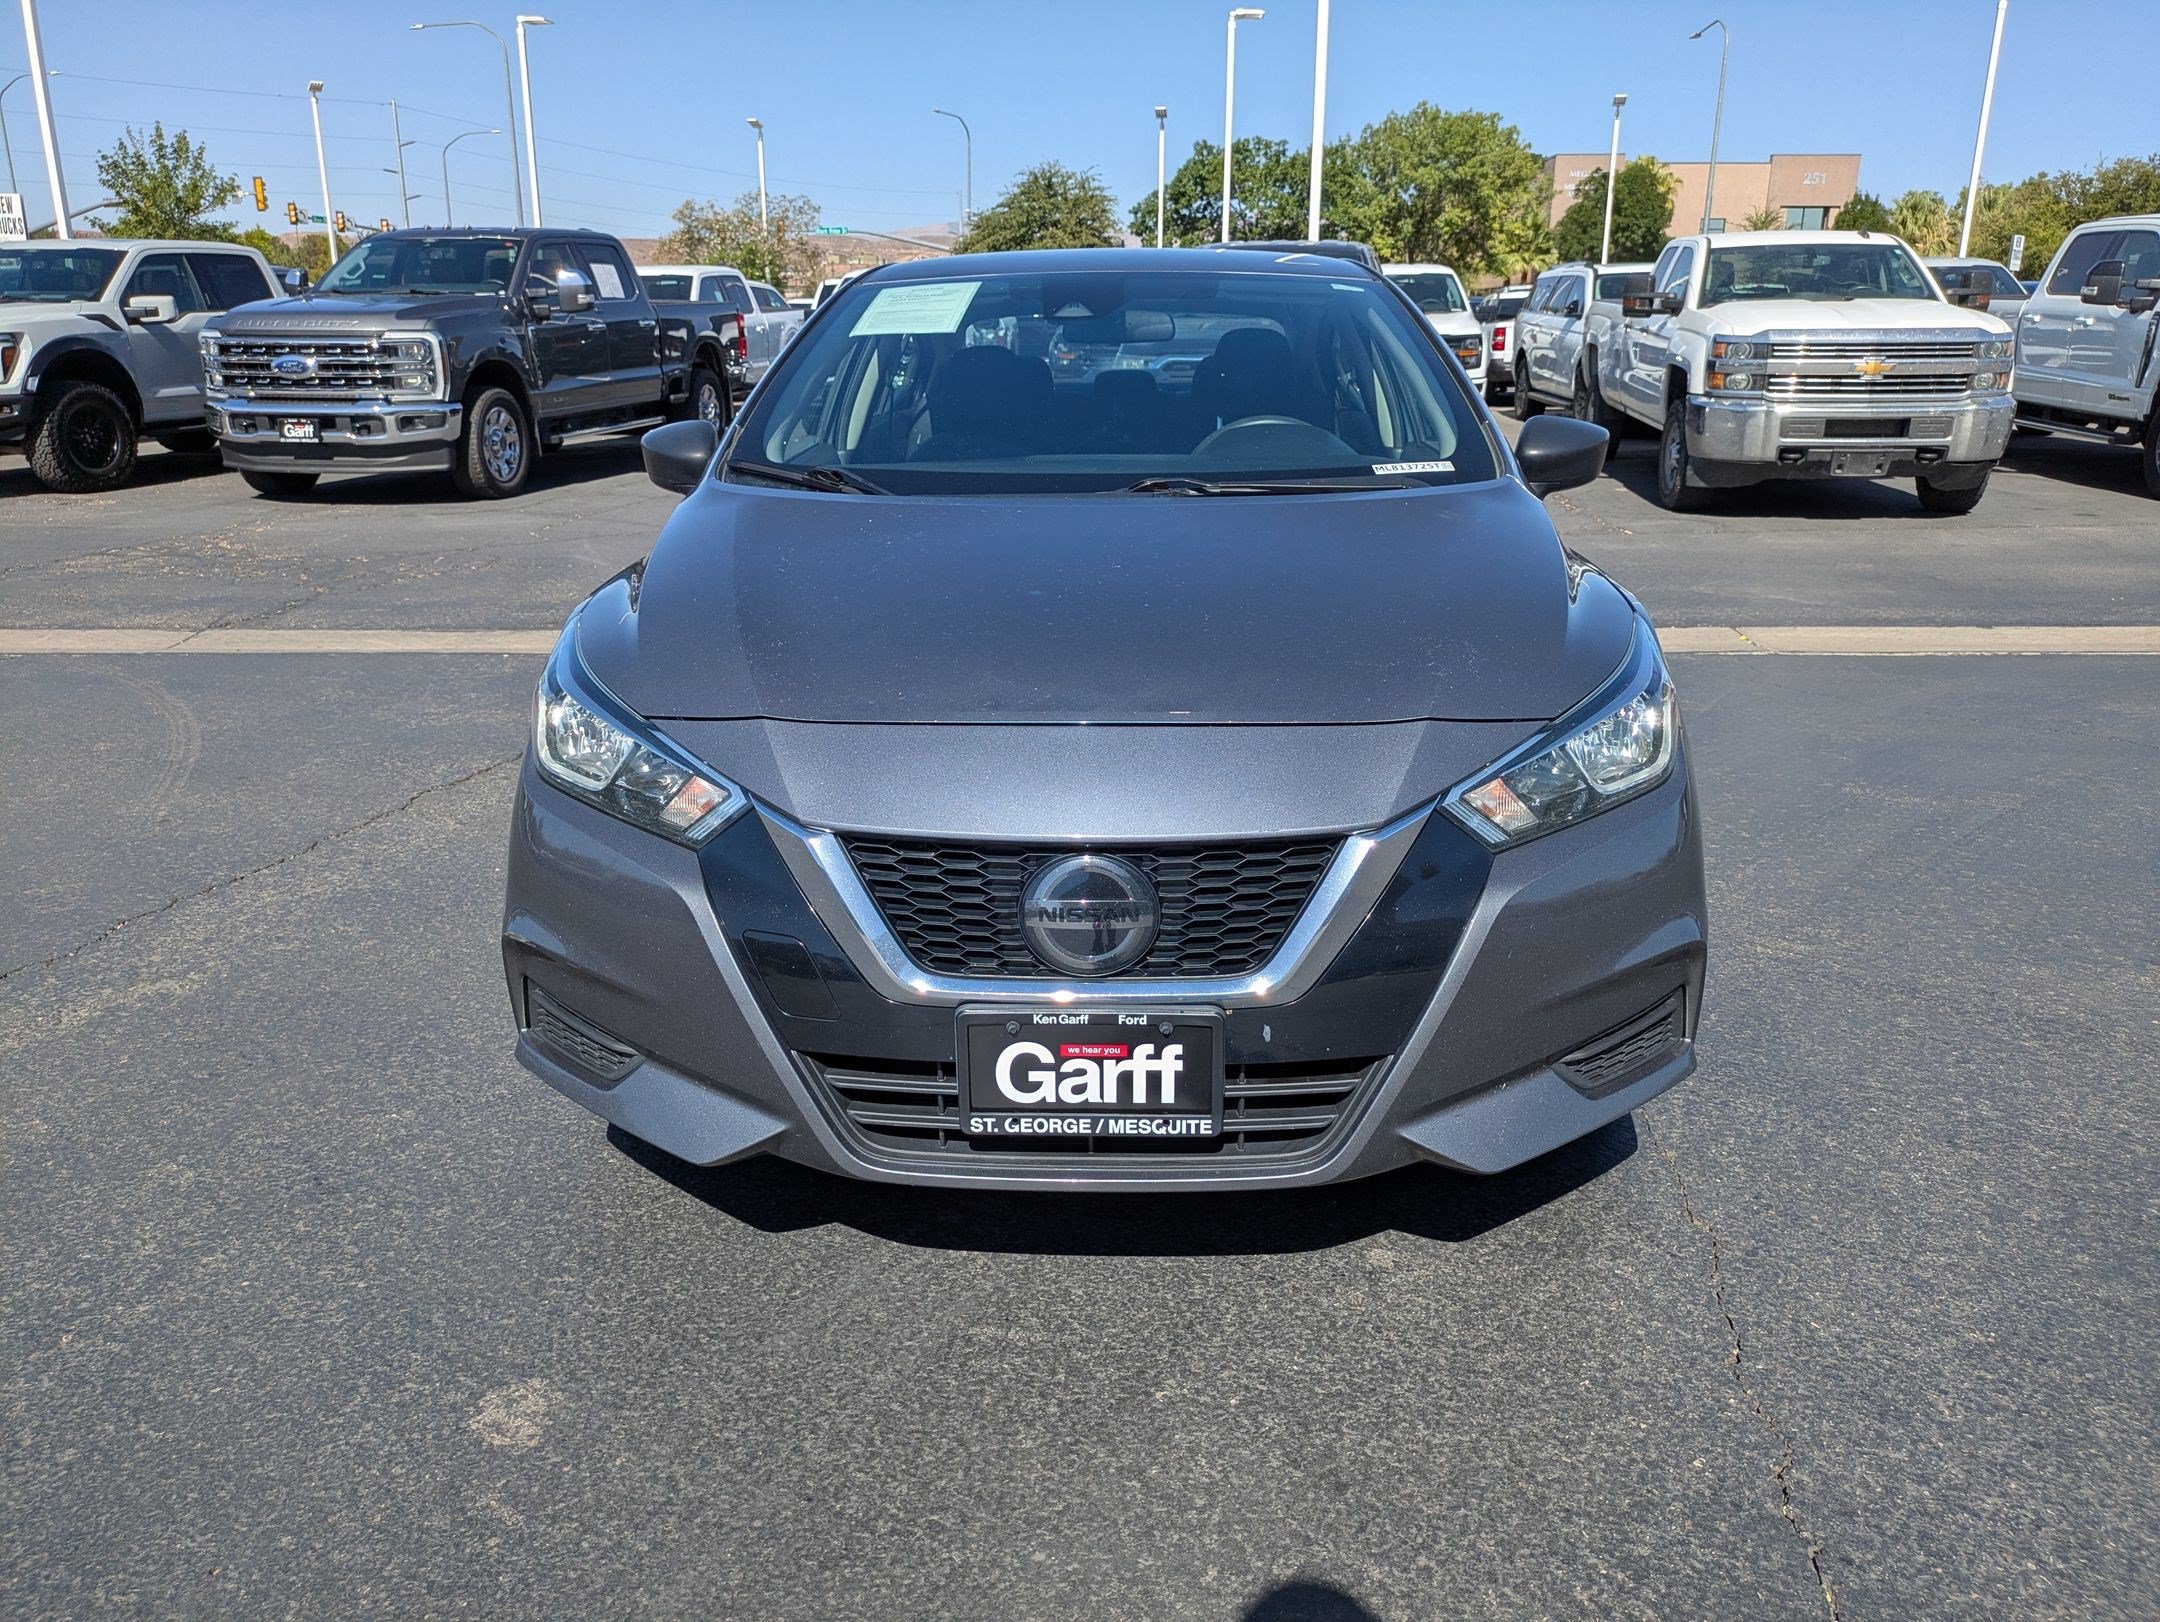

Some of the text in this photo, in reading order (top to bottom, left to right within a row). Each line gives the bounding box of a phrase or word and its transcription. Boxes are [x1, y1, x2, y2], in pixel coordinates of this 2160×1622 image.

[1803, 172, 1826, 185] 251
[0, 195, 13, 214] EW
[284, 424, 314, 437] Garff
[1038, 906, 1140, 923] NISSAN
[1033, 1014, 1147, 1025] Ken Garff Ford
[1082, 1046, 1102, 1054] hear
[1103, 1047, 1121, 1056] you
[995, 1041, 1184, 1104] Garff
[969, 1117, 999, 1133] ST.
[1004, 1117, 1092, 1134] GEORGE
[1108, 1118, 1213, 1135] MESQUITE
